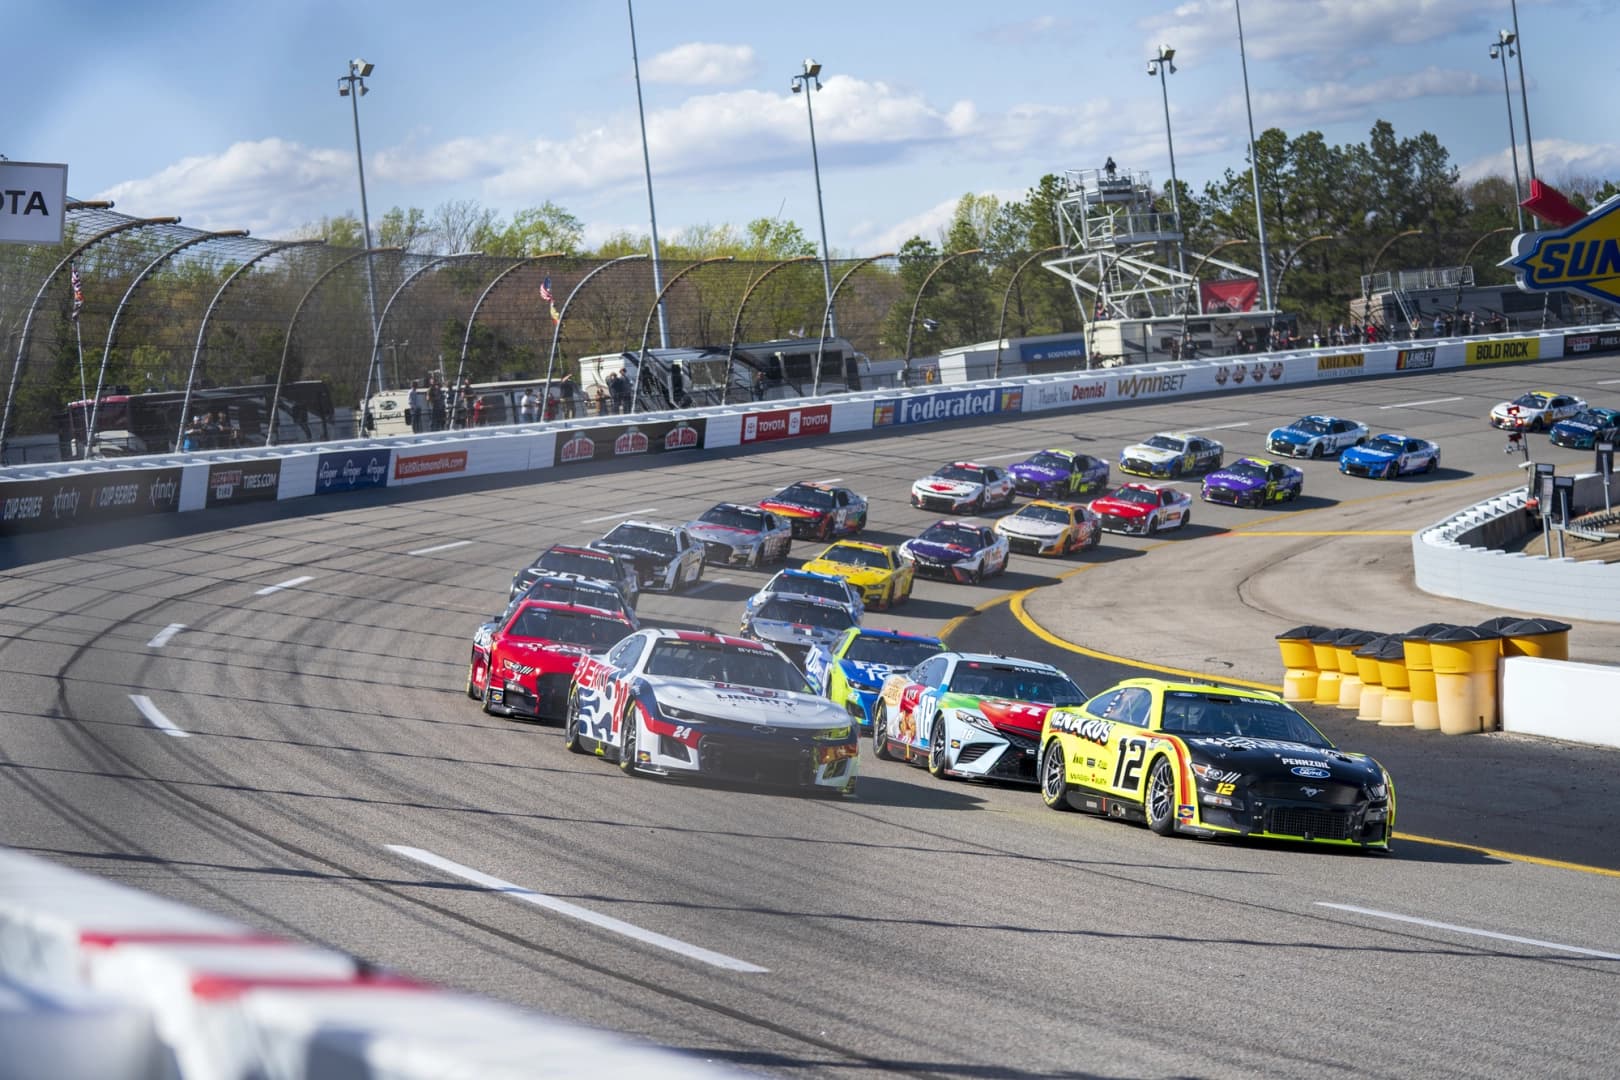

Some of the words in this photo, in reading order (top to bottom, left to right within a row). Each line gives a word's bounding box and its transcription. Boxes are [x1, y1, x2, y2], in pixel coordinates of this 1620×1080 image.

[0, 190, 49, 216] TA
[1476, 343, 1501, 360] BOLD
[1503, 342, 1529, 358] ROCK
[1040, 385, 1057, 404] Thank
[1059, 386, 1070, 402] You
[1071, 381, 1106, 401] Dennis!
[900, 389, 996, 423] Federated
[759, 419, 785, 432] TOYOTA
[802, 414, 828, 426] TOYOTA
[243, 473, 277, 488] TIRES.COM
[319, 461, 338, 487] Kroger
[343, 459, 362, 484] Kroger
[367, 457, 386, 482] Kroger
[99, 486, 114, 507] CUP
[114, 484, 139, 505] SERIES
[150, 477, 177, 506] xfinity
[984, 486, 991, 502] 8
[3, 498, 19, 520] CUP
[19, 496, 43, 518] SERIES
[53, 487, 80, 518] xfinity
[738, 647, 773, 657] BYRON
[1014, 666, 1037, 674] KYLE
[716, 693, 795, 707] LIBERTY
[920, 694, 936, 740] 18
[673, 726, 692, 740] 24
[960, 729, 975, 741] 18
[1050, 711, 1114, 746] MENARDS
[1113, 737, 1147, 793] 12
[1281, 757, 1331, 770] PENNZOIL
[1295, 767, 1326, 778] Ford
[1215, 782, 1236, 796] 12
